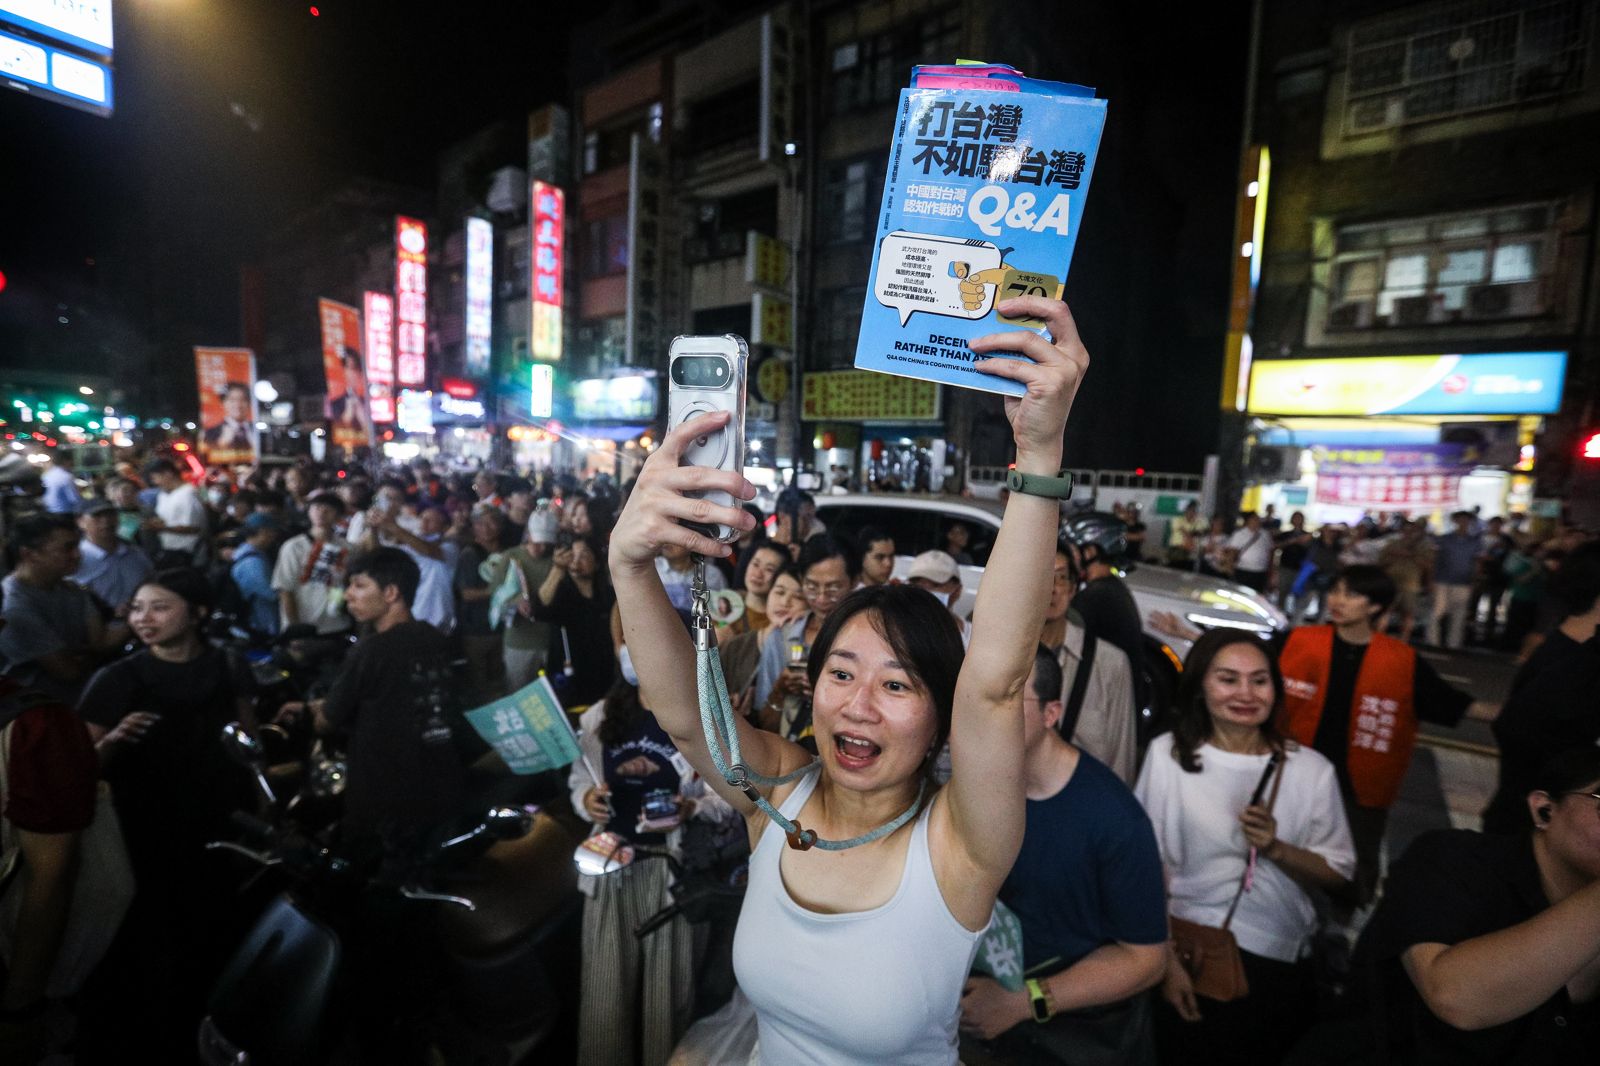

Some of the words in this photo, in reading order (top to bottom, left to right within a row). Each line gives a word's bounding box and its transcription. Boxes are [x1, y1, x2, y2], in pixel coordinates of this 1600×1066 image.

[917, 101, 1023, 143] 打台灣
[906, 183, 967, 203] 中國對台灣
[903, 199, 964, 218] 認知作戰的
[968, 185, 1070, 237] Q&A
[1017, 275, 1044, 284] 大塊文化
[929, 334, 970, 349] DECEIV
[894, 341, 938, 357] RATHER
[939, 348, 971, 362] THAN
[908, 358, 929, 366] CHINA'S
[930, 361, 960, 371] COGNITIVE
